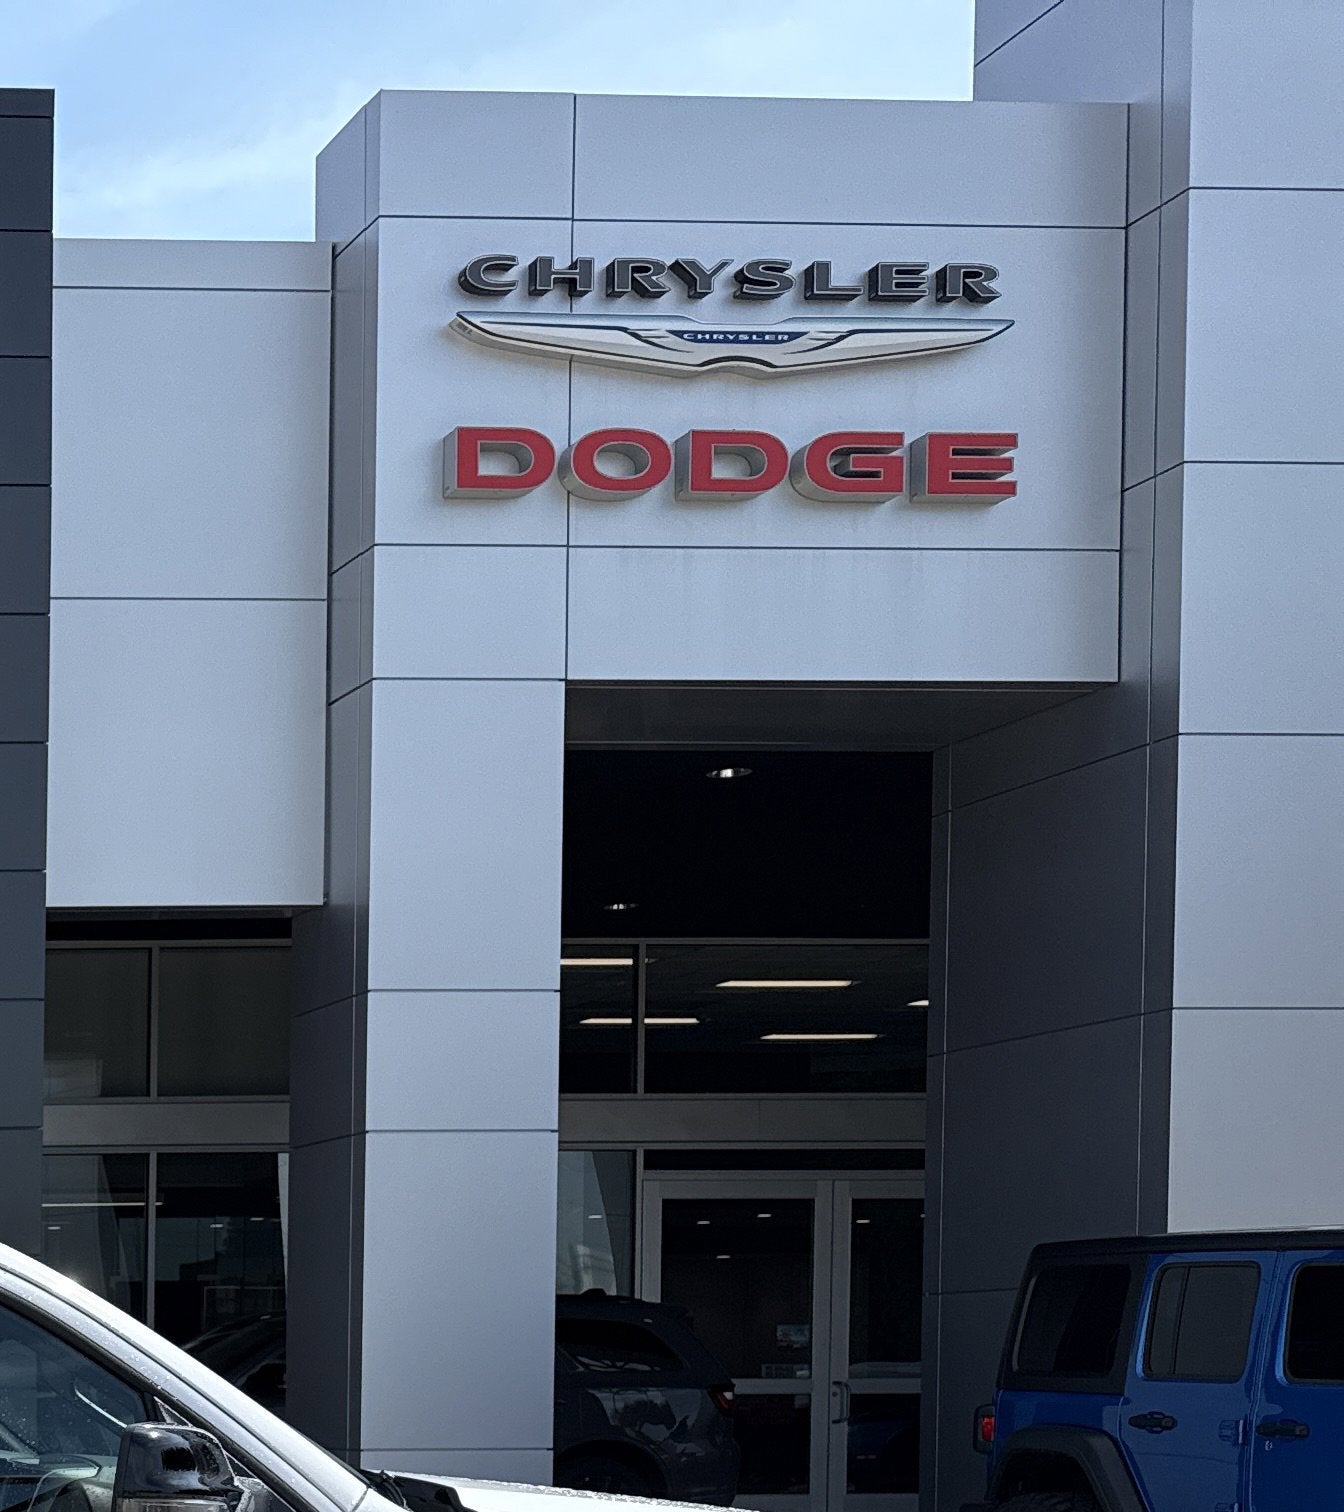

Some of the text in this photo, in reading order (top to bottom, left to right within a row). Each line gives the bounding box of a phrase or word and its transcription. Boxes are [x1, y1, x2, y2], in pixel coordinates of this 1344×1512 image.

[459, 255, 1002, 302] CHRYSLER
[682, 332, 790, 343] CHRYSLER
[444, 426, 1018, 501] DODGE
